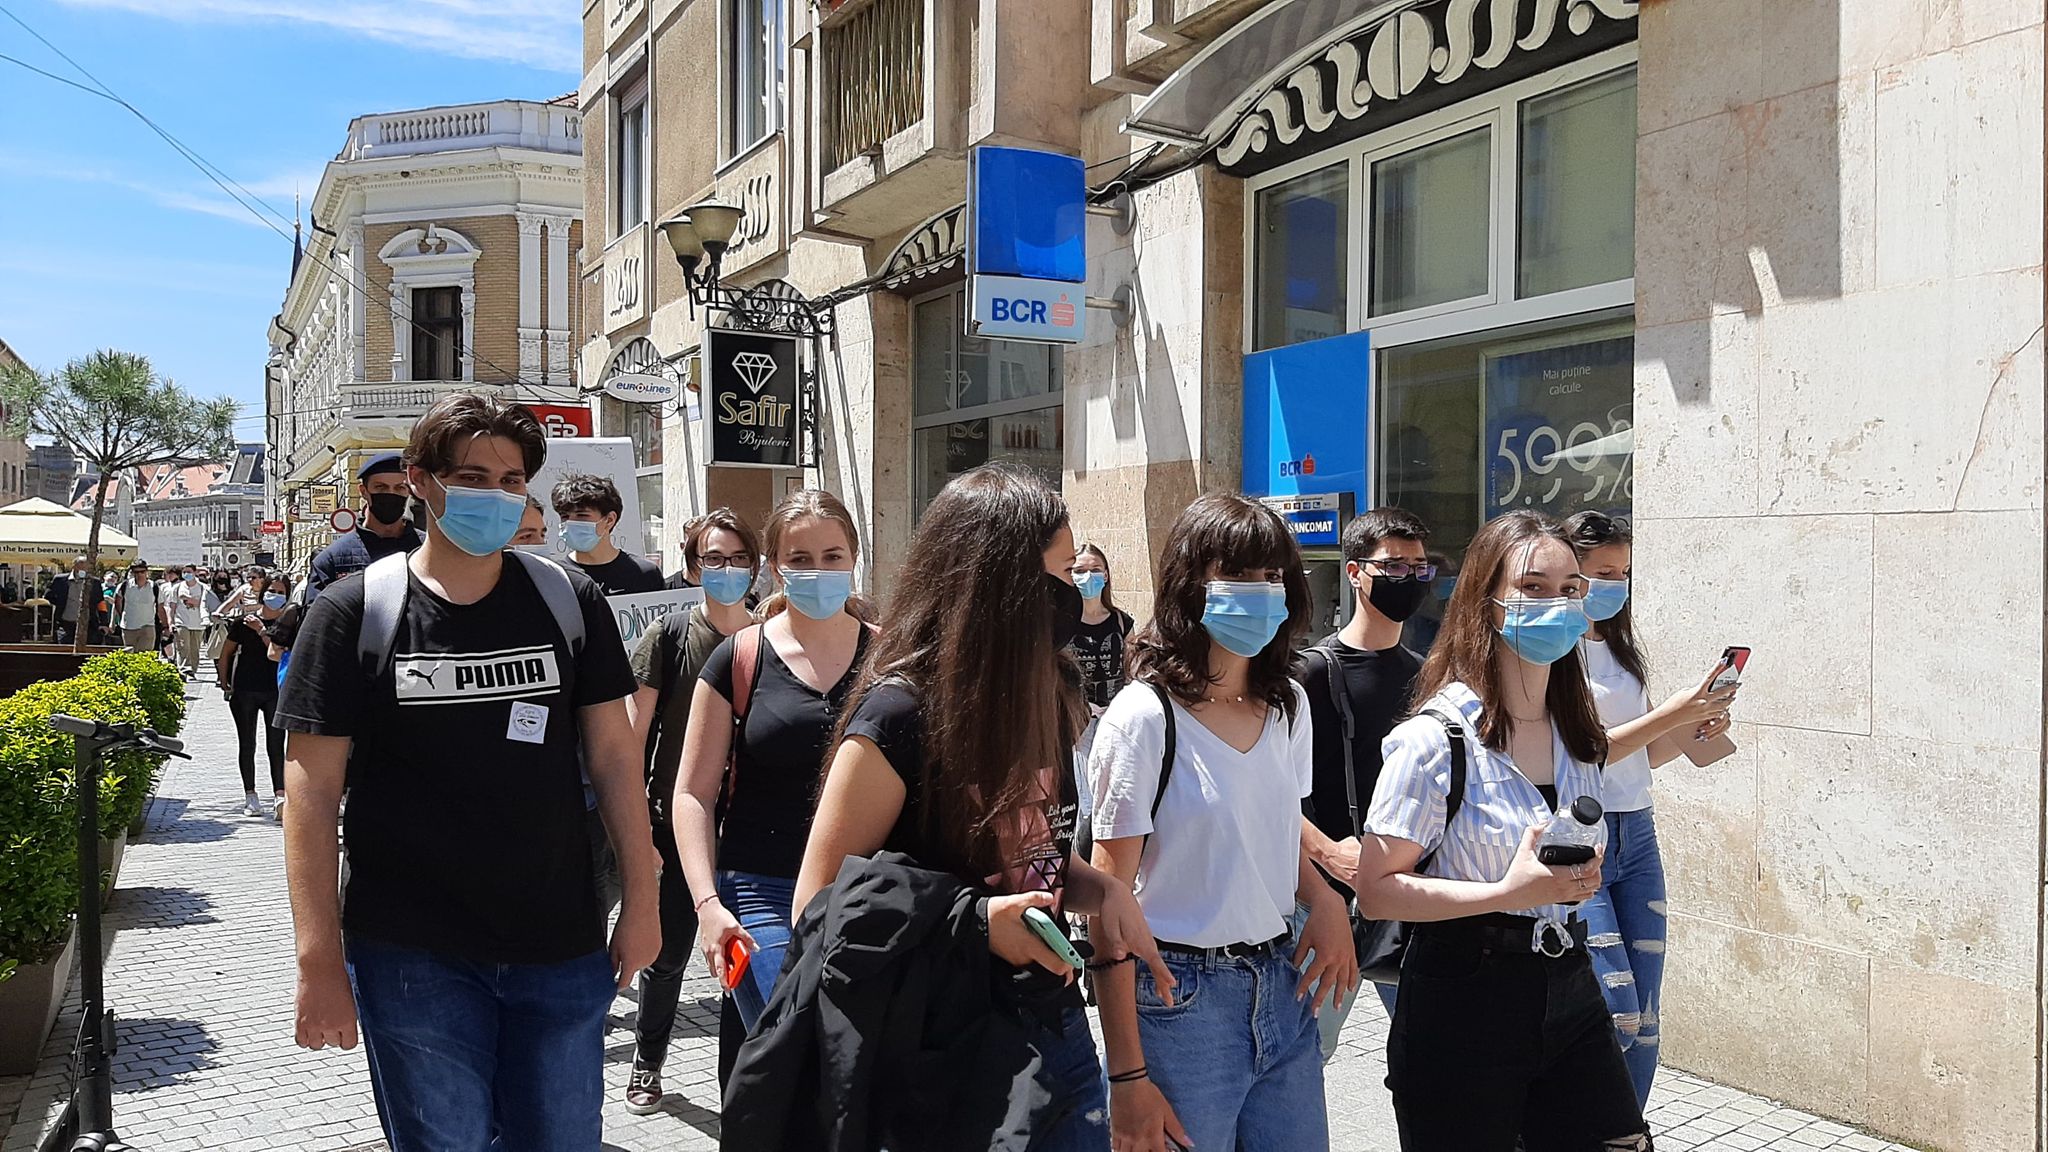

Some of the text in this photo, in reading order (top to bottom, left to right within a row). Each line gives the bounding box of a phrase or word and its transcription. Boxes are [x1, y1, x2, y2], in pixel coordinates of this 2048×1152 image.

[991, 297, 1047, 325] BCR
[1543, 368, 1560, 380] Mai
[718, 392, 792, 428] Safir
[738, 429, 792, 449] Bijuterii
[1280, 461, 1301, 476] BCR
[455, 658, 546, 691] PUMA
